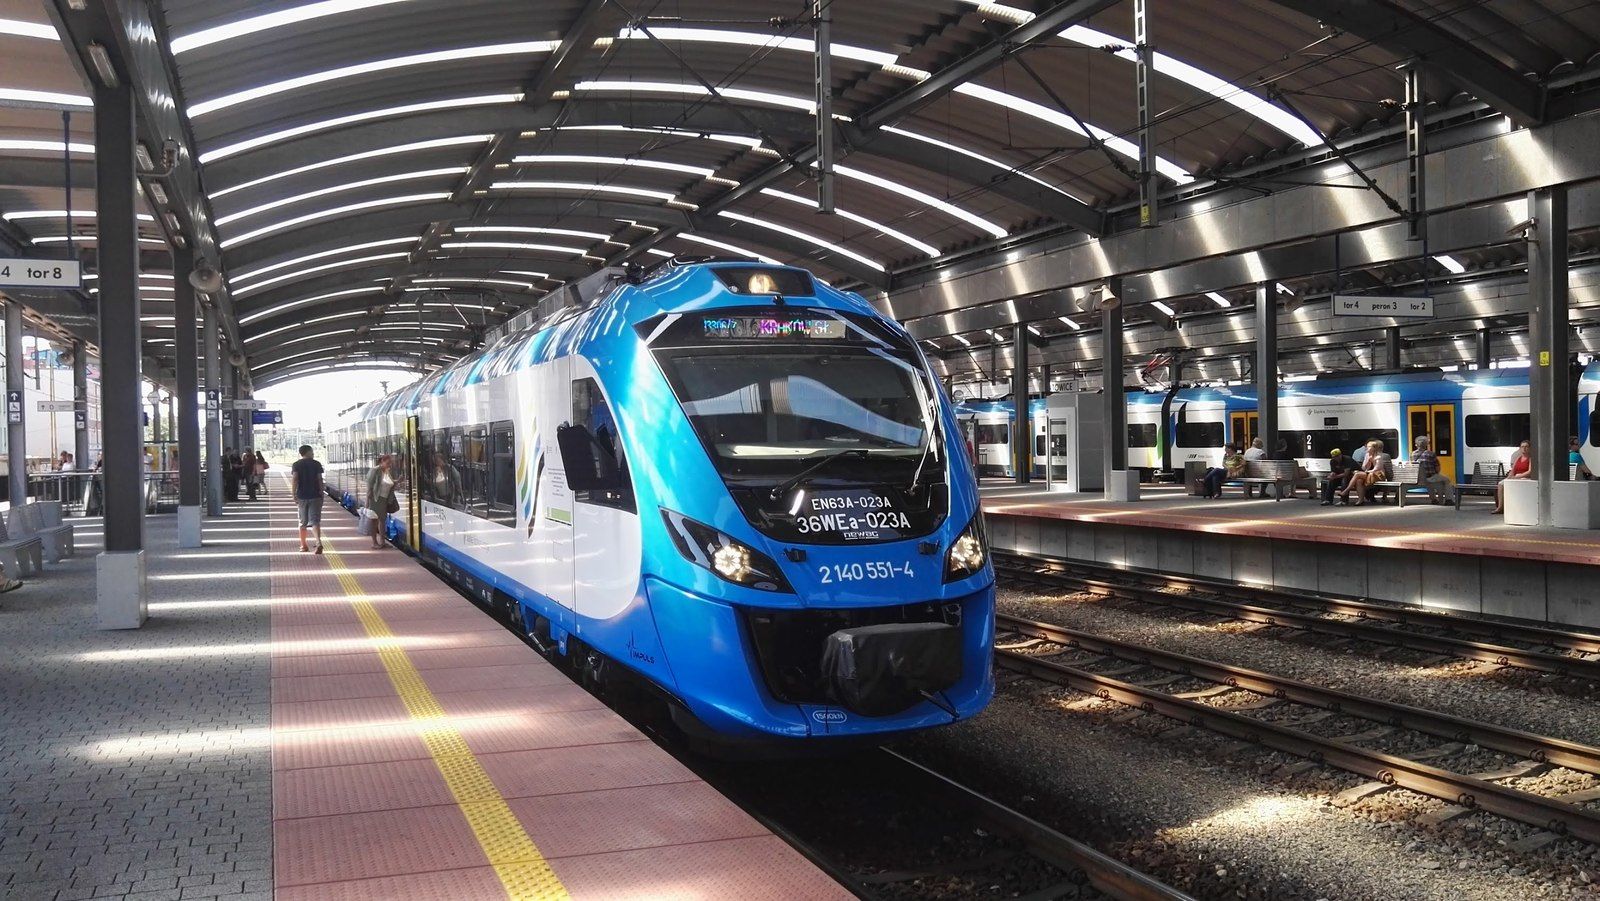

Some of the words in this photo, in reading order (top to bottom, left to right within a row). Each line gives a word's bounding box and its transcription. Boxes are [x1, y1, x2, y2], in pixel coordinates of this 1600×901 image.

[1, 265, 11, 278] 4
[27, 267, 49, 279] tor
[53, 267, 62, 279] 8
[1343, 301, 1354, 309] tor
[1354, 301, 1359, 309] 4
[1372, 303, 1391, 311] peron
[1392, 301, 1398, 310] 3
[1421, 302, 1426, 310] 2
[1306, 434, 1312, 445] 2
[811, 496, 892, 510] EN63A-023A
[797, 512, 911, 534] 36WEa-023A
[819, 566, 833, 584] 2
[834, 563, 864, 582] 140
[866, 560, 914, 579] 551-4
